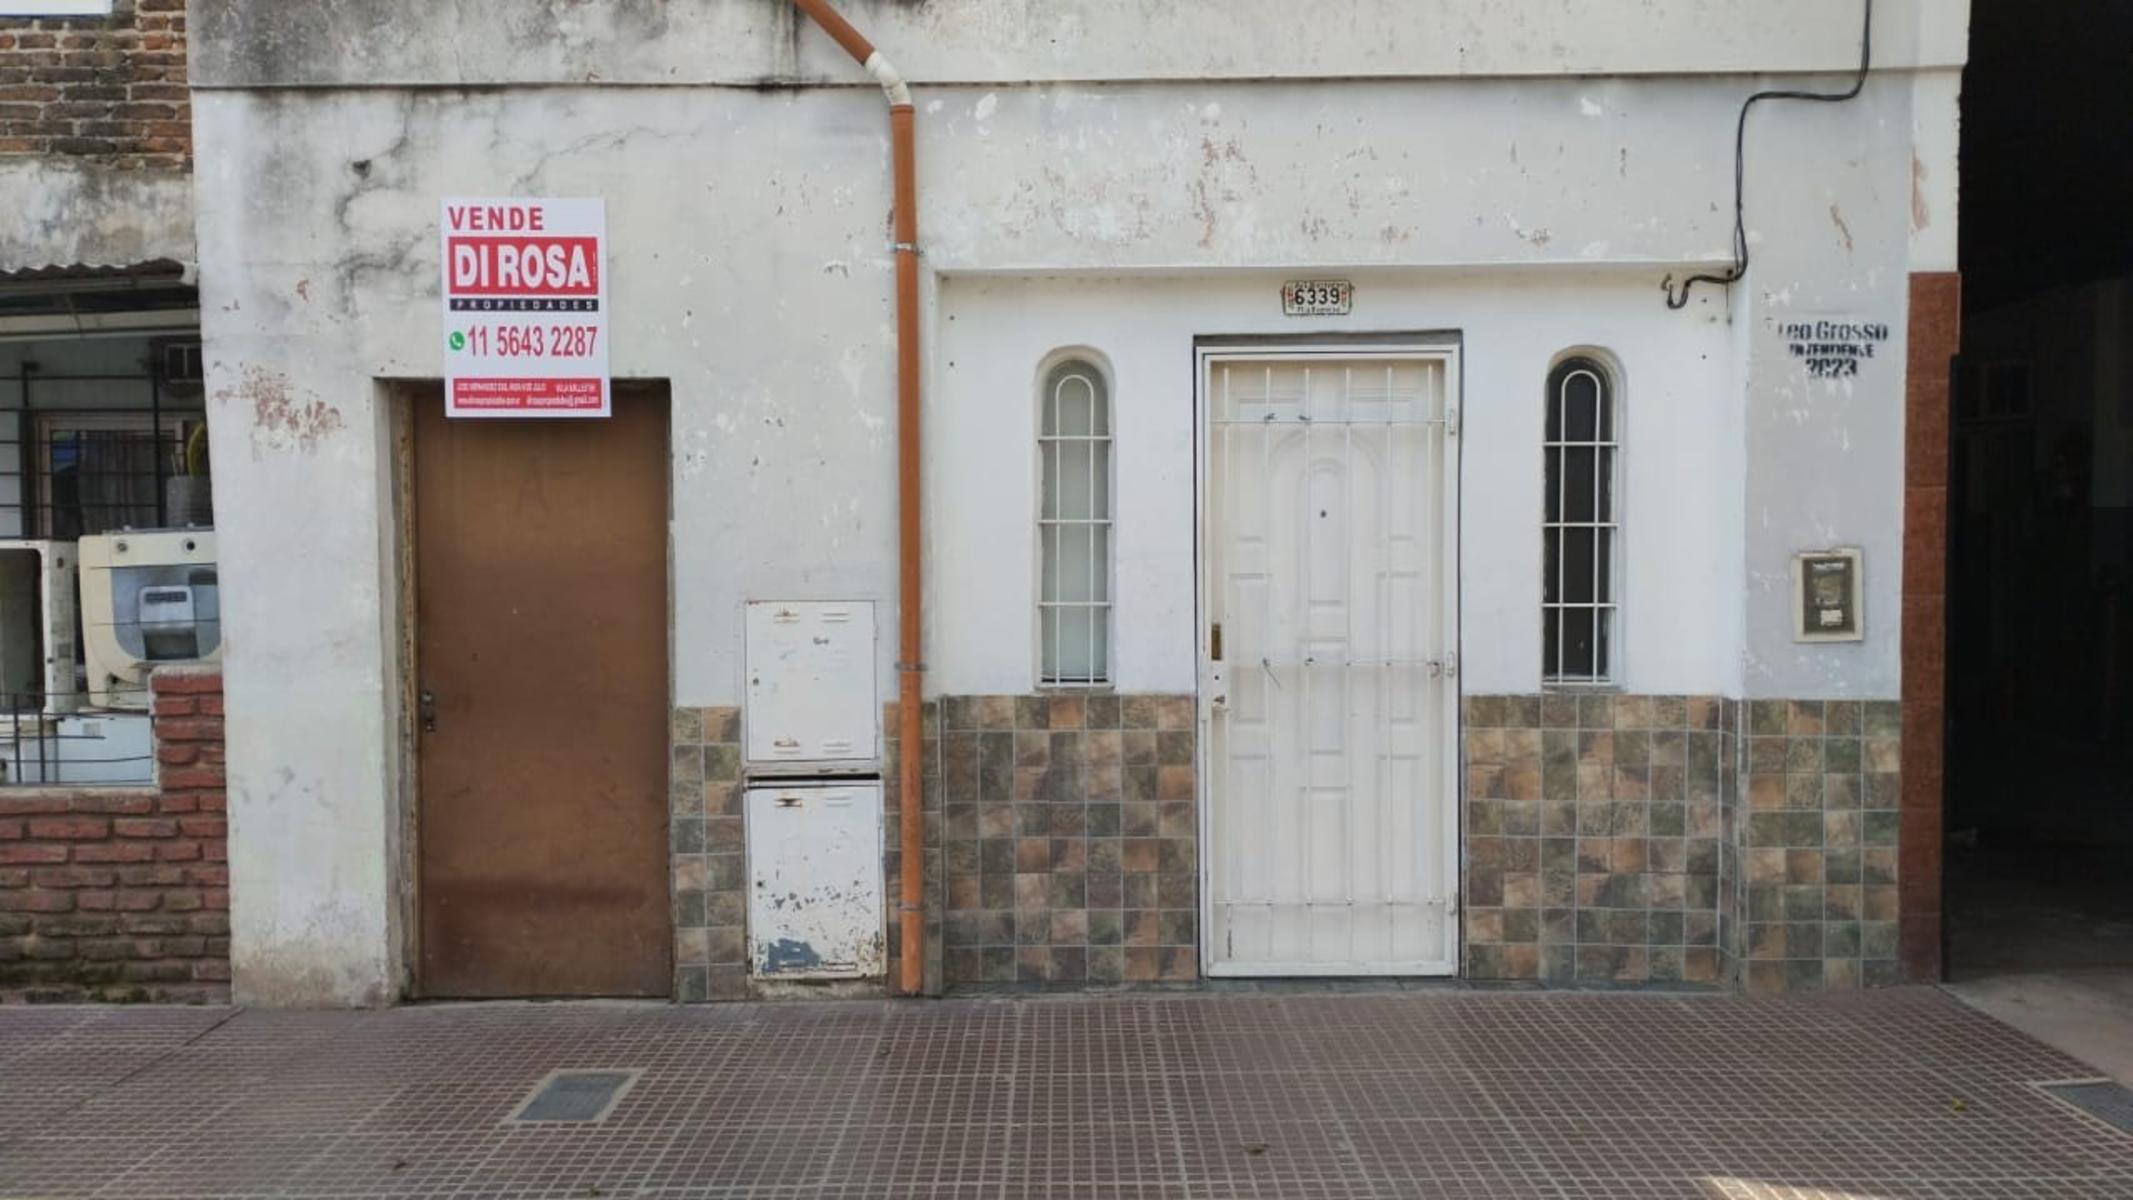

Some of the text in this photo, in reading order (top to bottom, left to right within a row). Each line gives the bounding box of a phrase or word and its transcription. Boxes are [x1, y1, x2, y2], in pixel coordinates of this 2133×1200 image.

[448, 206, 544, 231] VENDE
[454, 244, 489, 288] DI
[496, 243, 591, 289] ROSA
[456, 300, 593, 310] PROPIEDADES
[1295, 287, 1340, 305] 6339
[1816, 320, 1888, 341] Grosso
[468, 326, 598, 357] 11 5643 2287
[1805, 358, 1858, 379] 2023
